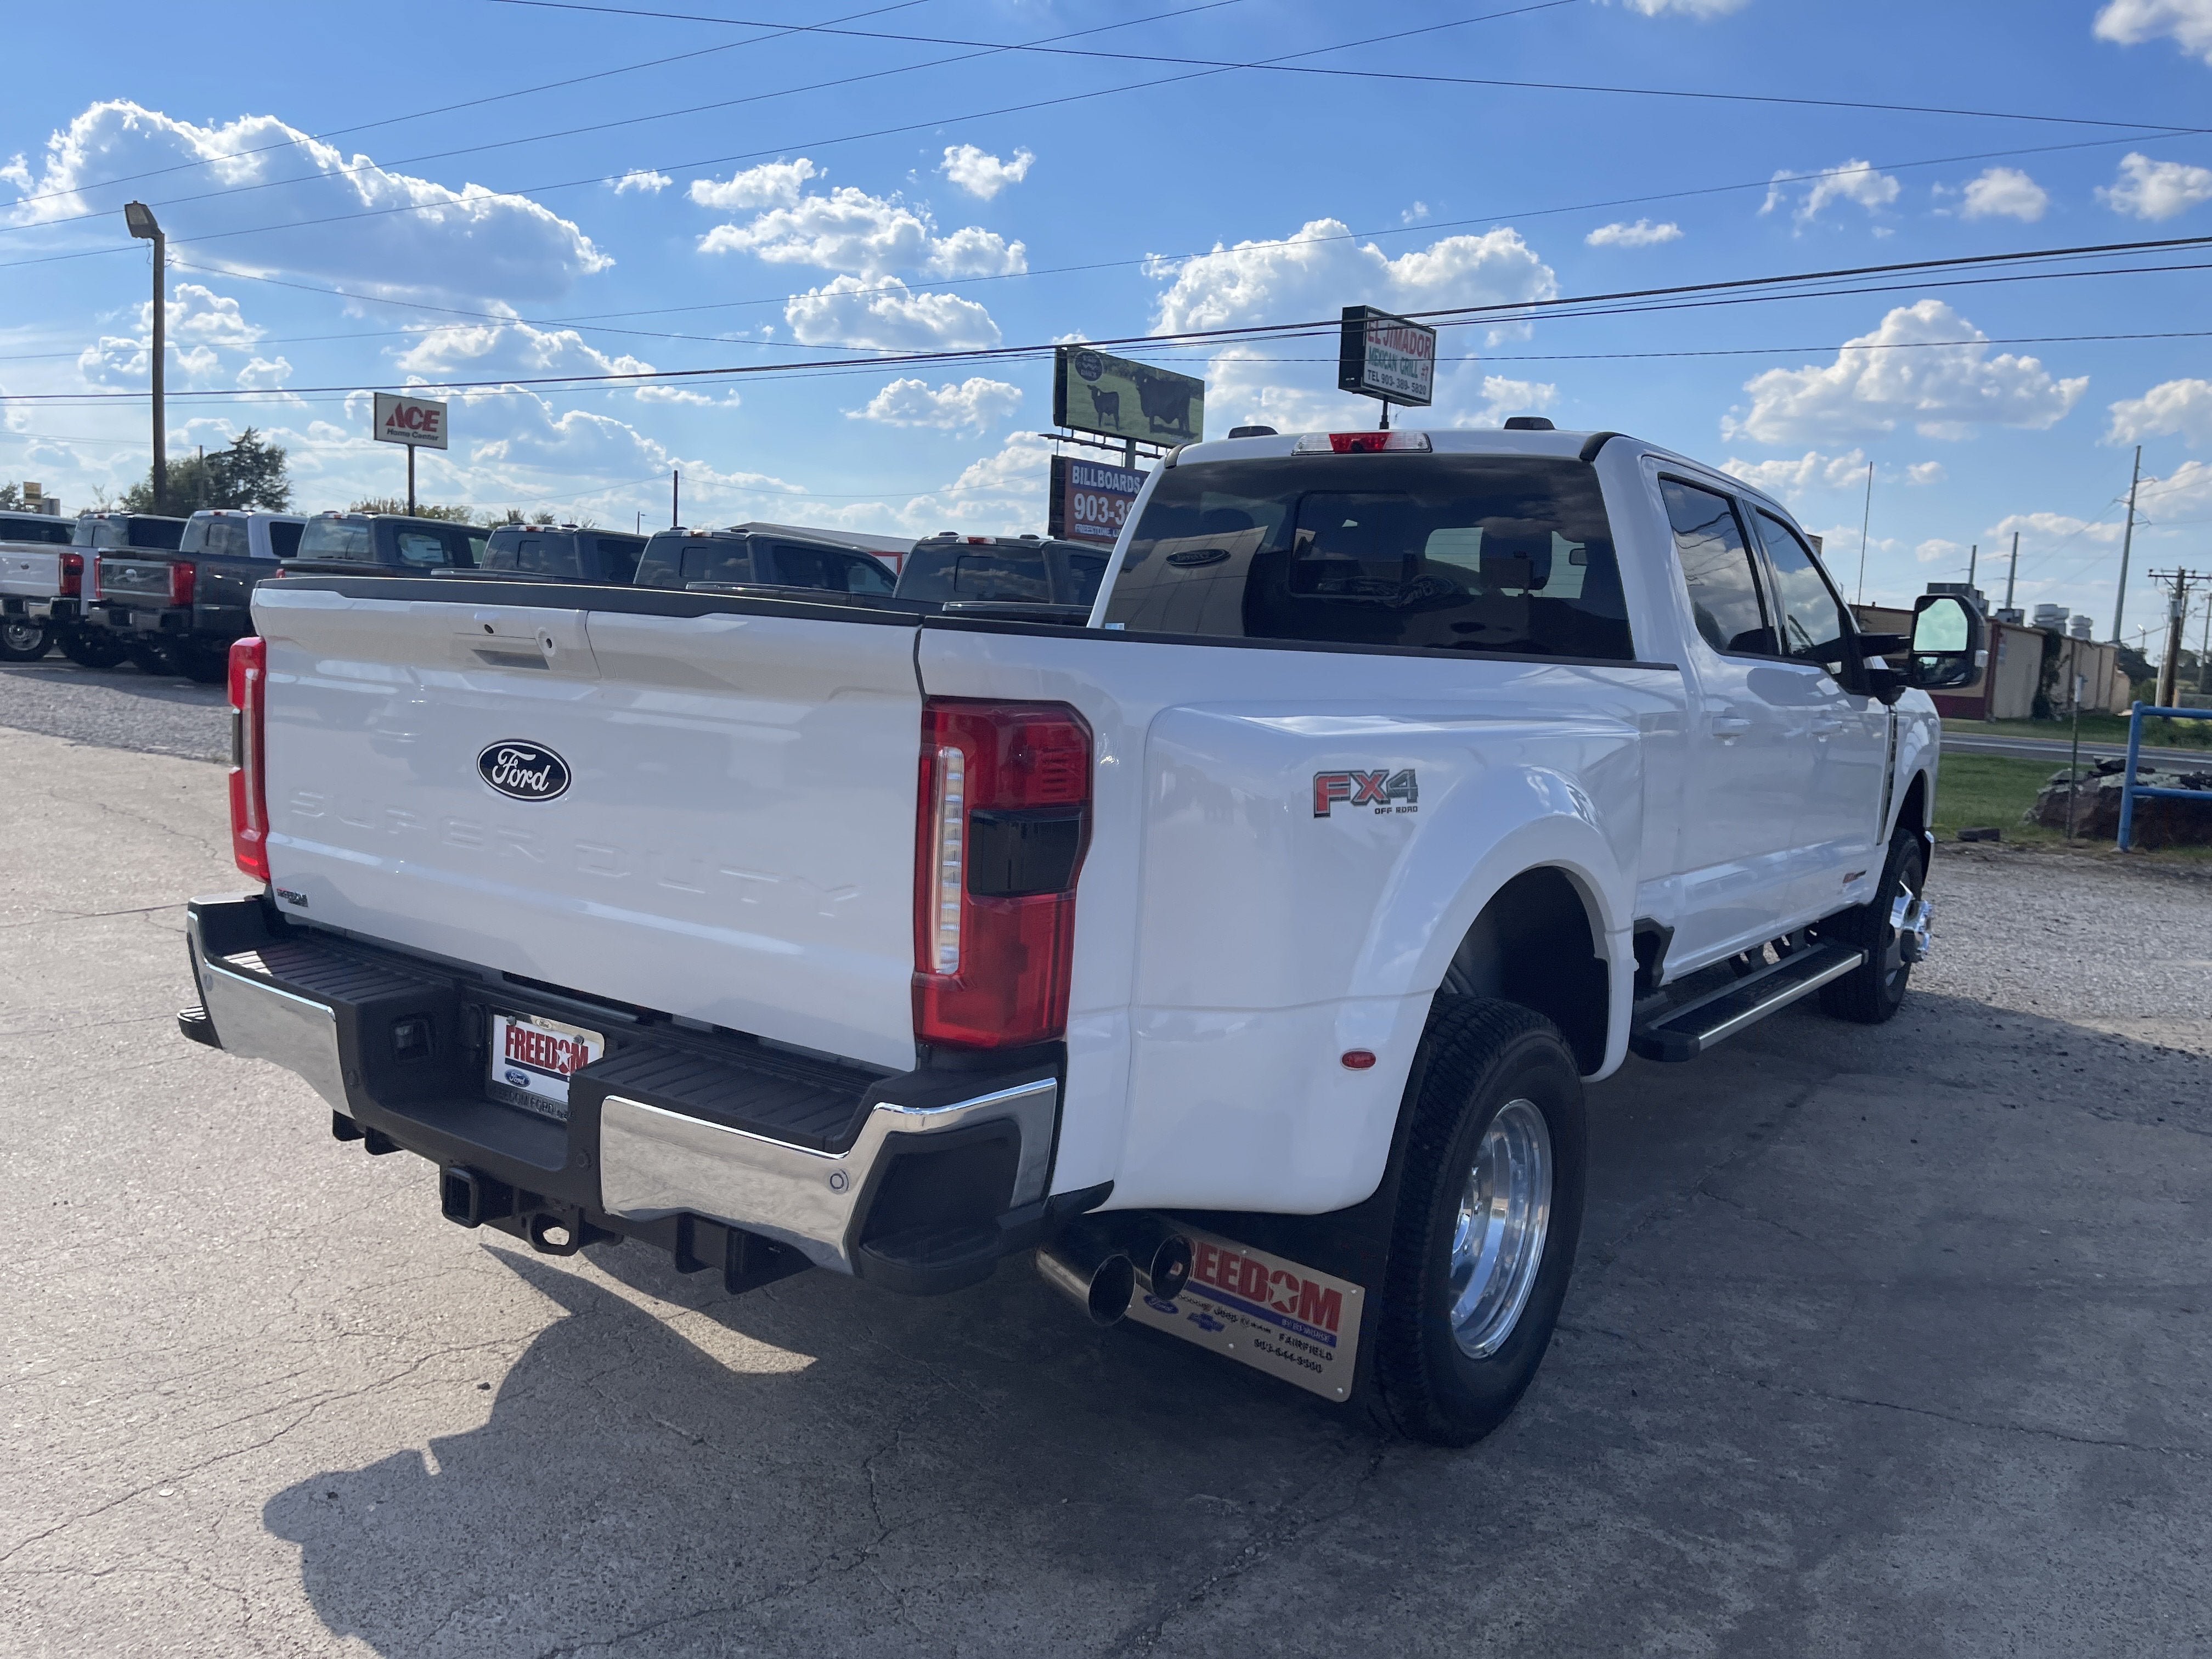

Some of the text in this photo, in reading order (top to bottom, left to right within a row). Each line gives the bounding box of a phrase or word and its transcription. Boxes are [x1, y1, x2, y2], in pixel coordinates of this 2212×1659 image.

[1368, 320, 1431, 359] EL JIMADOR
[385, 402, 441, 432] ACE
[387, 428, 439, 441] Home Center
[1072, 466, 1141, 494] BILLBOARDS
[492, 748, 551, 792] Ford
[1313, 768, 1419, 819] FX4
[1374, 805, 1418, 815] OFF ROAD
[505, 1025, 589, 1074] FREEDOM
[1189, 1238, 1344, 1333] EEDOM
